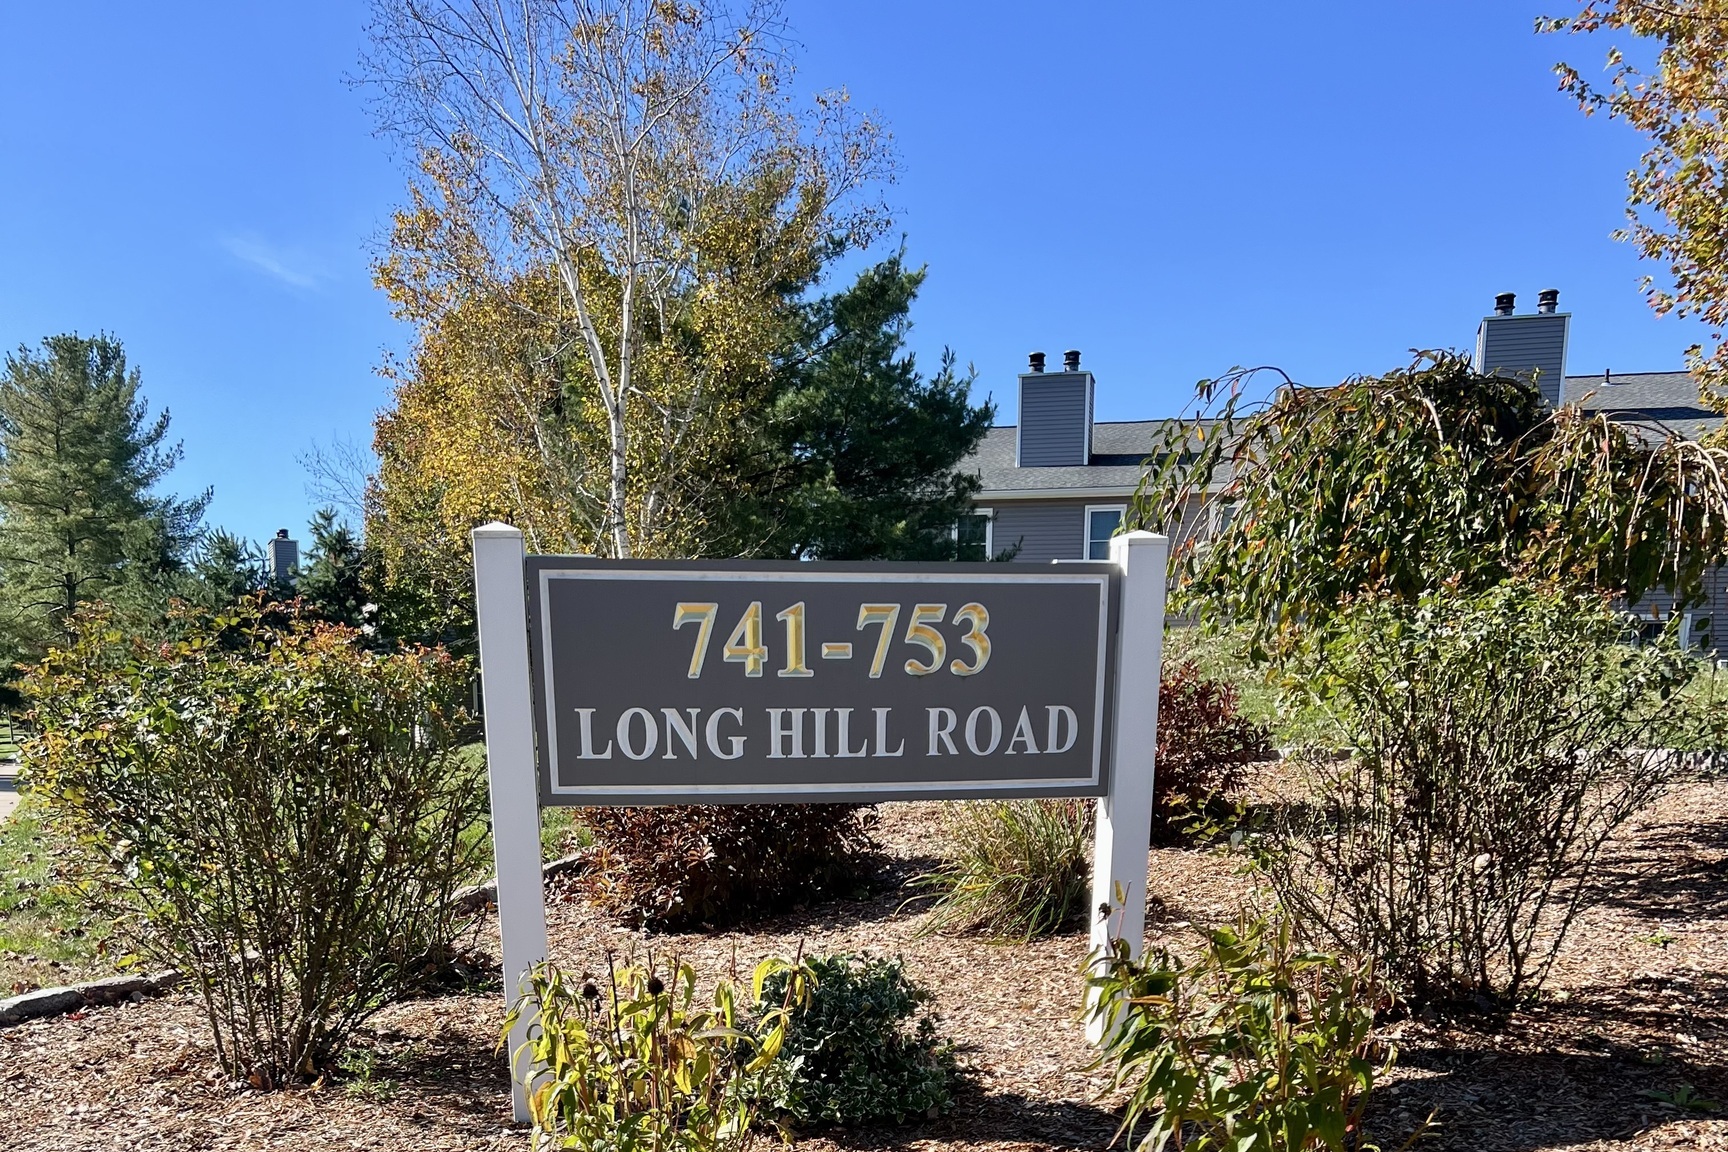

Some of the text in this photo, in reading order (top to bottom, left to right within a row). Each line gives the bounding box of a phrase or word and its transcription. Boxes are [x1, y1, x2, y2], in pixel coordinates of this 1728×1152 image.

[672, 600, 992, 679] 741-753
[574, 705, 1079, 761] LONG HILL ROAD
